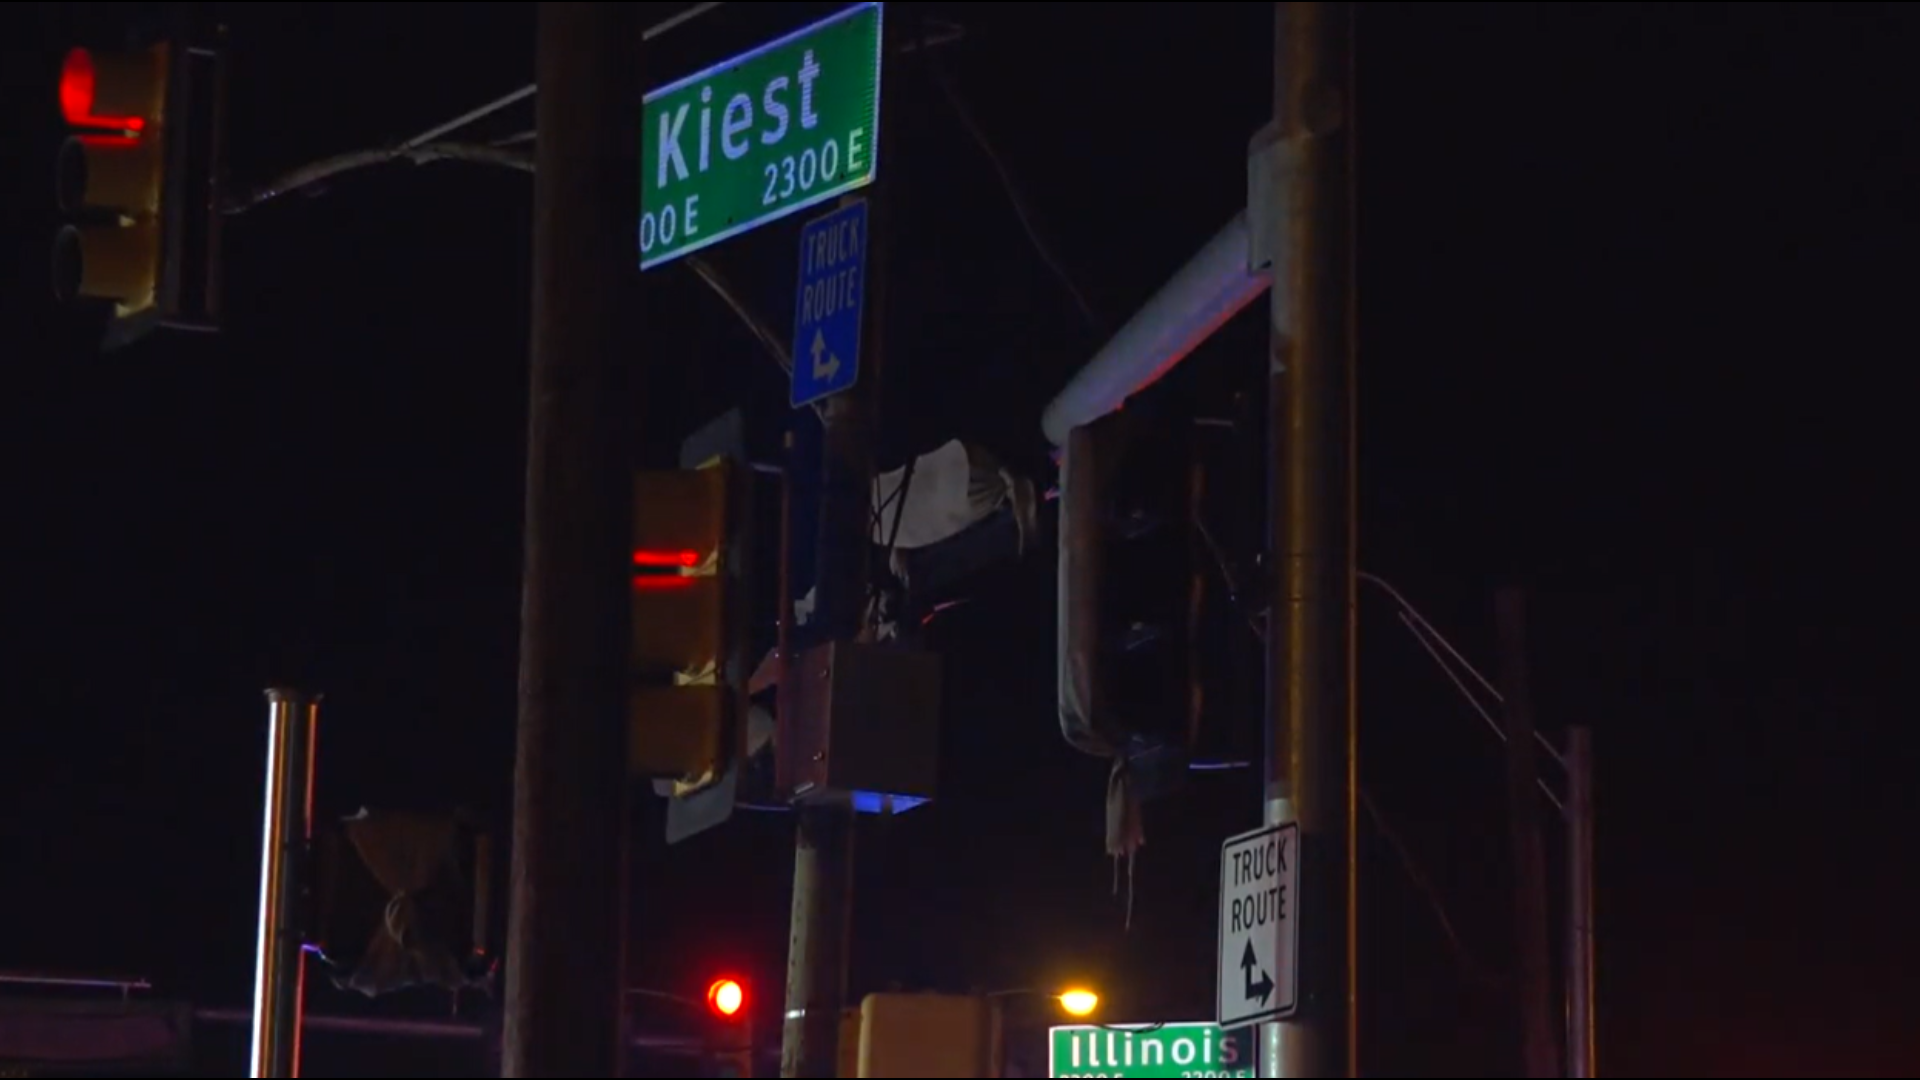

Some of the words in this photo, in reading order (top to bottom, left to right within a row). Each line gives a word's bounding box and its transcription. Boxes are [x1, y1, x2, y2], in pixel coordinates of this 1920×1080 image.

[657, 49, 820, 189] Kiest
[762, 138, 839, 206] 2300
[848, 127, 864, 173] E
[684, 194, 699, 236] E
[807, 216, 860, 276] TRUCK
[802, 266, 858, 326] ROUTE
[1233, 837, 1287, 888] TRUCK
[1231, 885, 1287, 934] ROUTE
[1072, 1028, 1239, 1067] Illinois
